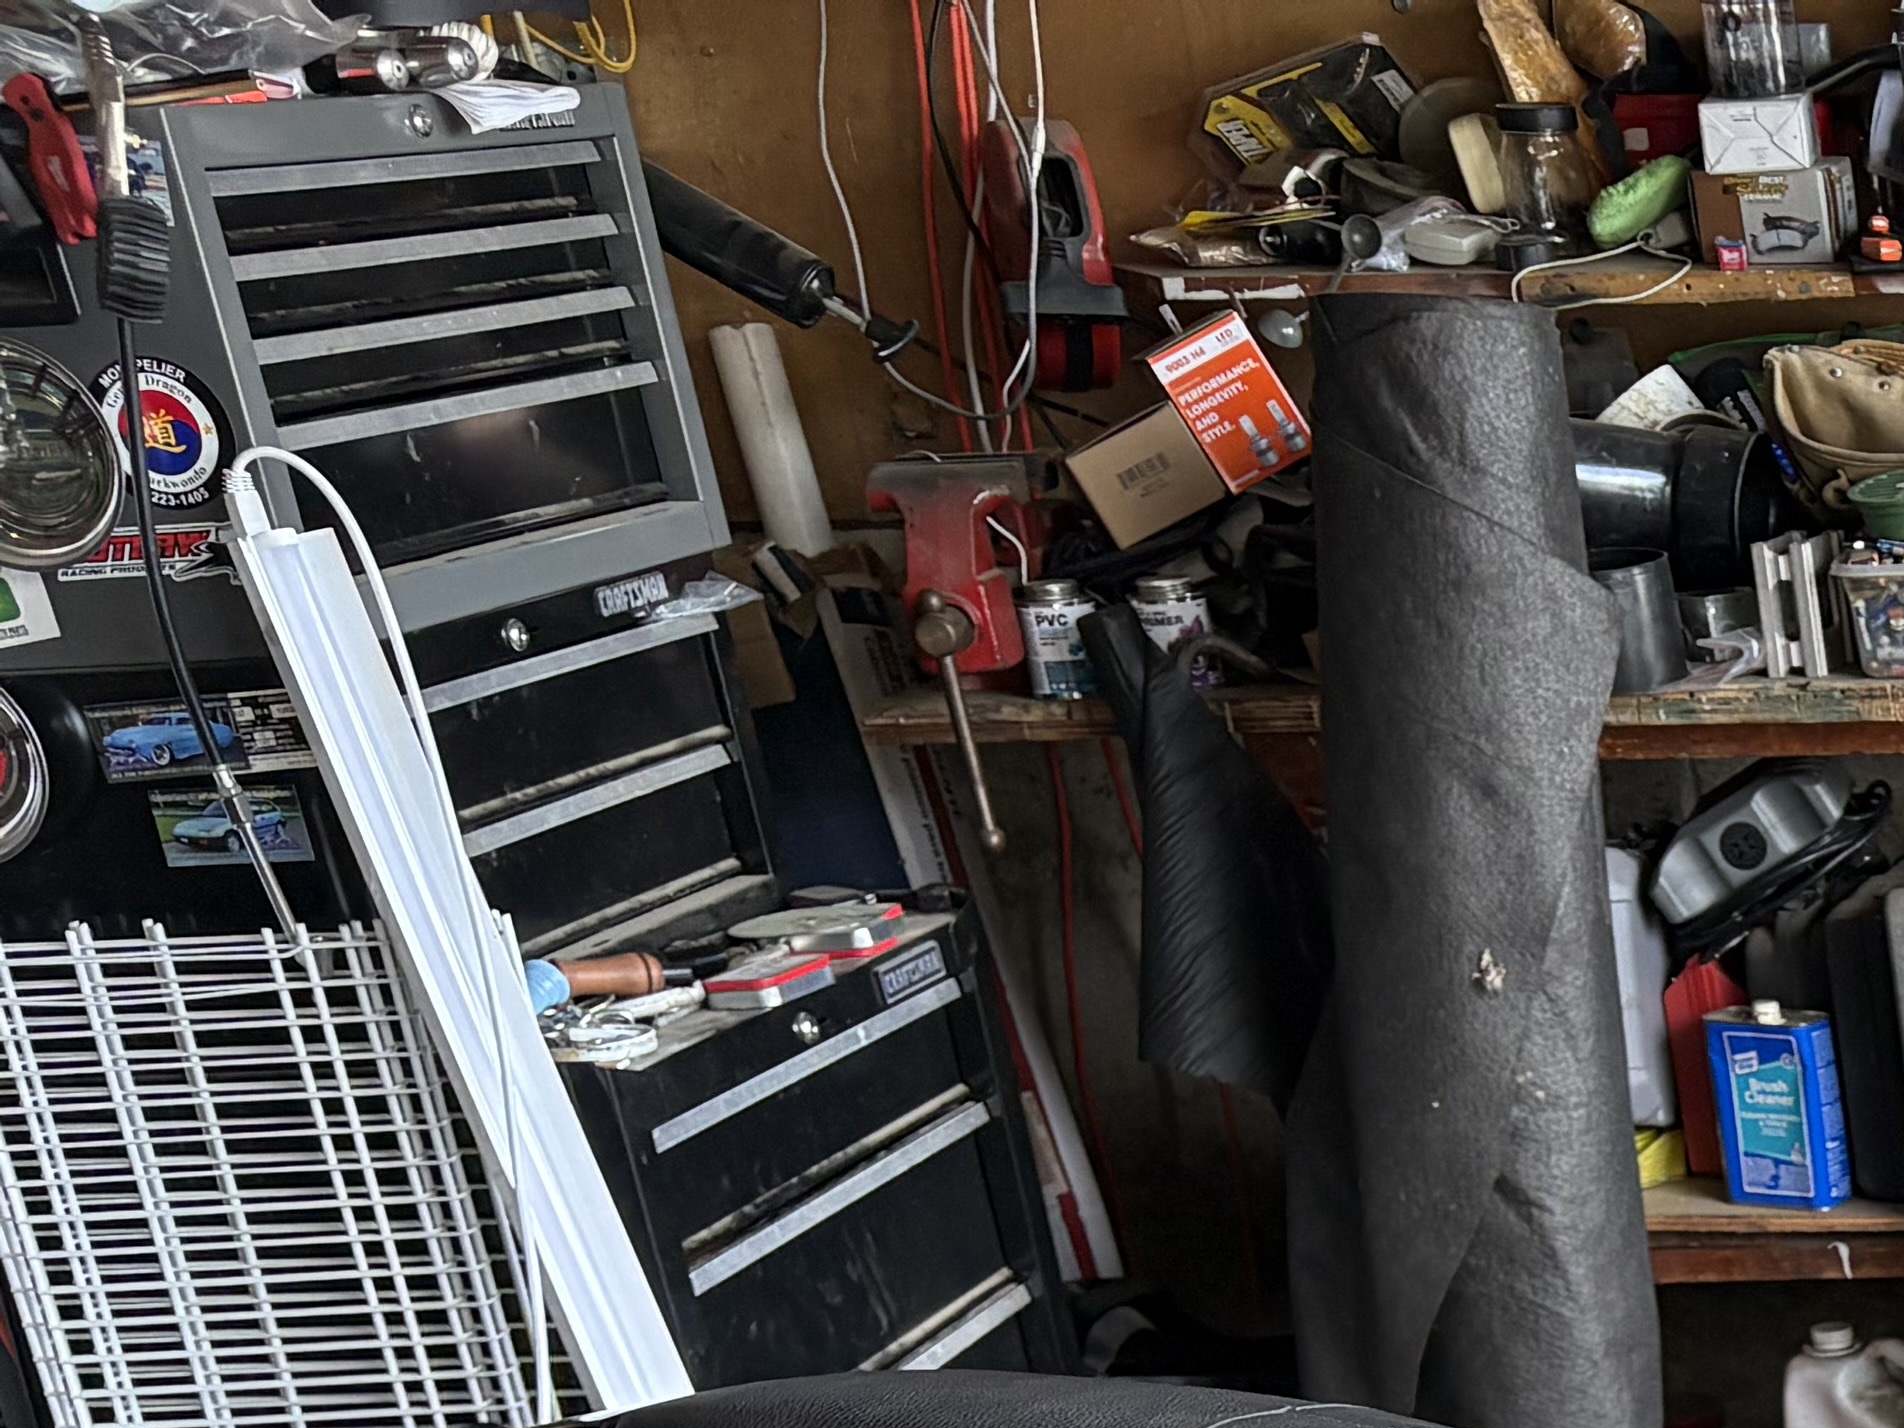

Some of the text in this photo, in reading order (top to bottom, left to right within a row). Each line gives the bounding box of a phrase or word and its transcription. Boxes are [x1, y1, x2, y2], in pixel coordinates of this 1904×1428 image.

[1214, 328, 1234, 344] LED
[1194, 412, 1220, 432] AND
[1034, 613, 1069, 627] PVC
[1747, 1077, 1789, 1094] Brush
[1744, 1090, 1795, 1107] Cleaner
